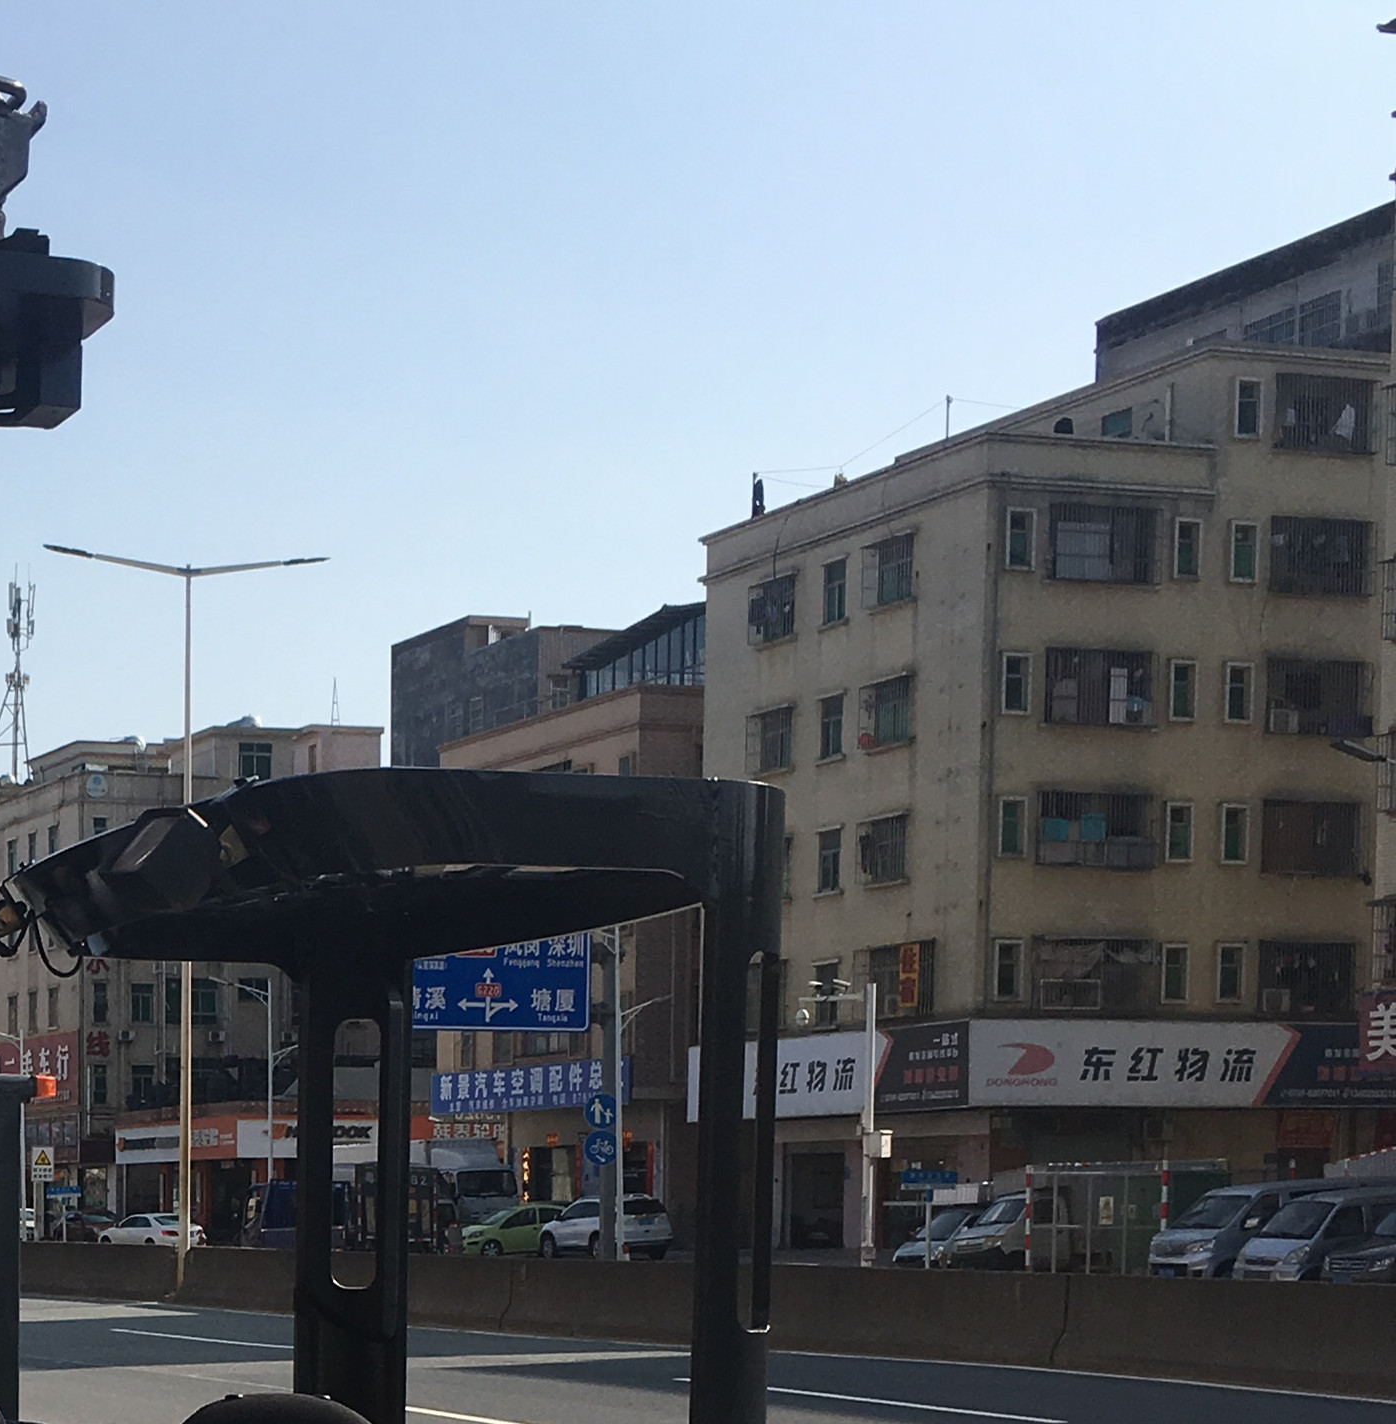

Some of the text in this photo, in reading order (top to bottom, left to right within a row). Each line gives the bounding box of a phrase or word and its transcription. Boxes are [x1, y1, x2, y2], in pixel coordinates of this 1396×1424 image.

[548, 934, 584, 958] 深圳
[547, 957, 584, 968] Shenzhen
[477, 985, 499, 996] G220
[531, 988, 575, 1012] 塘厦
[413, 1012, 439, 1023] ingxi
[538, 1013, 568, 1023] Tangxia
[1079, 1047, 1257, 1082] 东红物流
[439, 1061, 623, 1101] 新景汽车空调配件总
[753, 1057, 856, 1096] 红物流
[285, 1125, 373, 1139] HOOK
